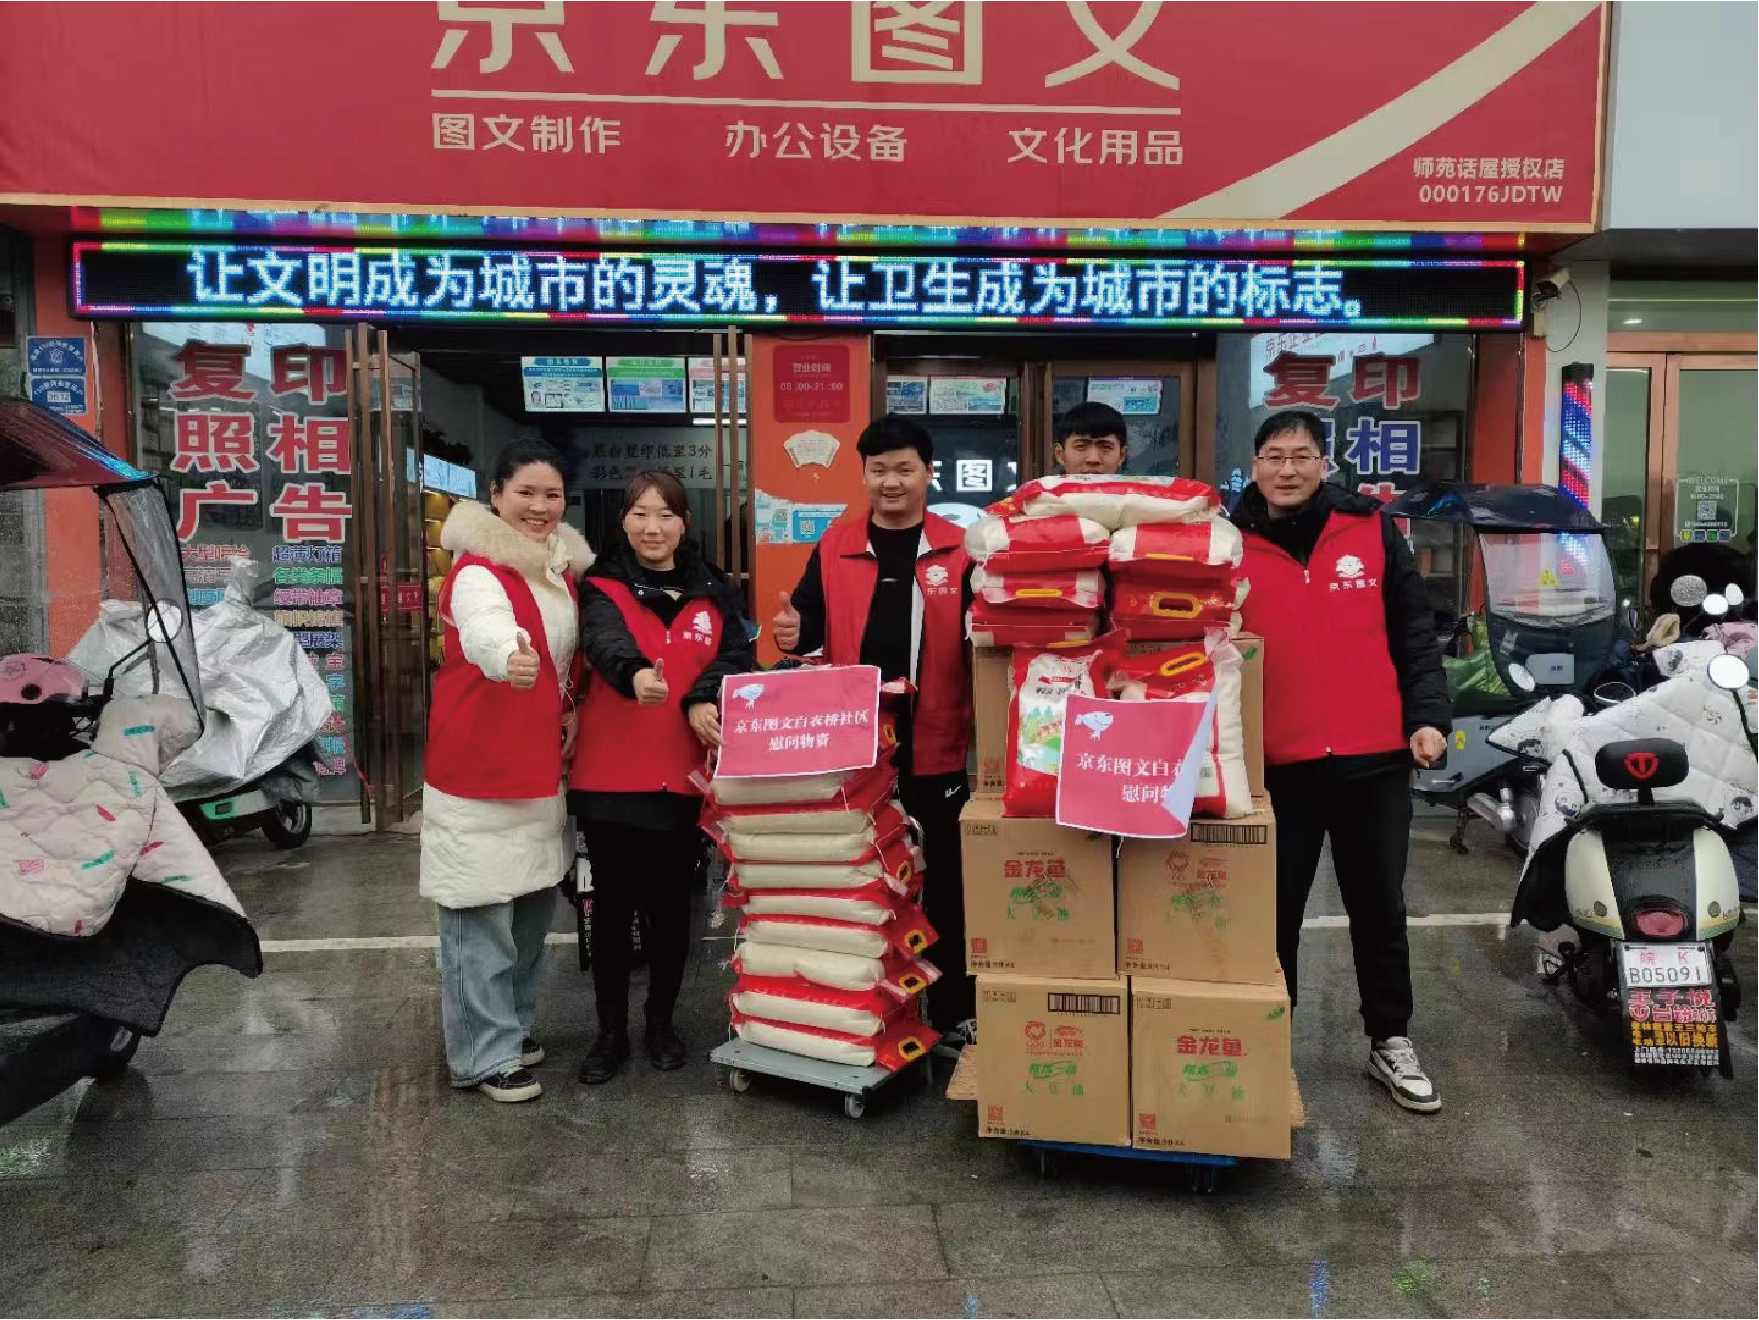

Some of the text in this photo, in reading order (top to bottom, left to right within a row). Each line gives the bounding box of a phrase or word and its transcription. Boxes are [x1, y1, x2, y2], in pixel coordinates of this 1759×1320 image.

[432, 112, 1185, 166] 图文制作 办公设备 文化用品
[1413, 157, 1564, 180] 师苑话屋授权店
[1419, 185, 1563, 203] 000176JDTW
[170, 339, 348, 405] 复印
[1263, 351, 1422, 410] 复印
[170, 411, 352, 473] 照相
[177, 480, 352, 544] 广告
[1005, 859, 1066, 878] 金龙鱼
[1177, 1035, 1242, 1056] 金龙鱼
